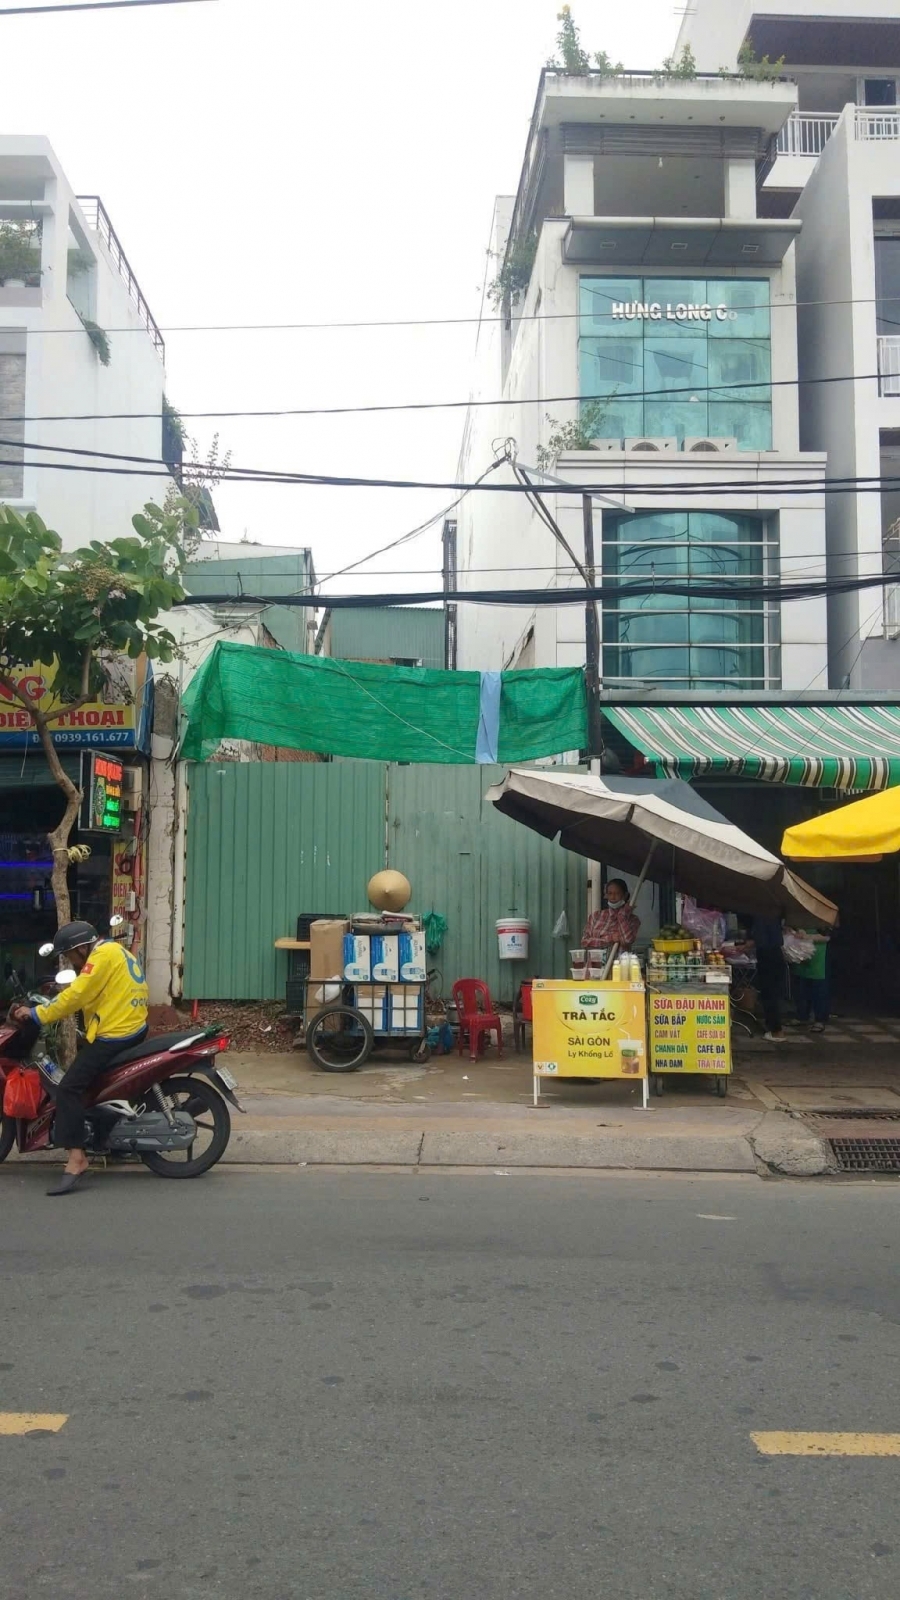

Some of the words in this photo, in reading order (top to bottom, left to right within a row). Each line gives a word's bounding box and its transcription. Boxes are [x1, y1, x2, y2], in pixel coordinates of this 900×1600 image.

[612, 301, 661, 320] HƯNG
[666, 303, 711, 321] LONG
[55, 732, 129, 742] 0939.161.677
[580, 995, 597, 1004] Cozy
[675, 998, 695, 1012] ĐẬU
[698, 998, 725, 1010] NÀNH
[562, 1009, 587, 1021] TRÀ
[591, 1008, 616, 1021] TẮC
[654, 1030, 668, 1038] CAM
[568, 1036, 584, 1046] SÀI
[587, 1036, 610, 1046] GÒN
[654, 1044, 676, 1053] CHANH
[568, 1050, 576, 1058] Ly
